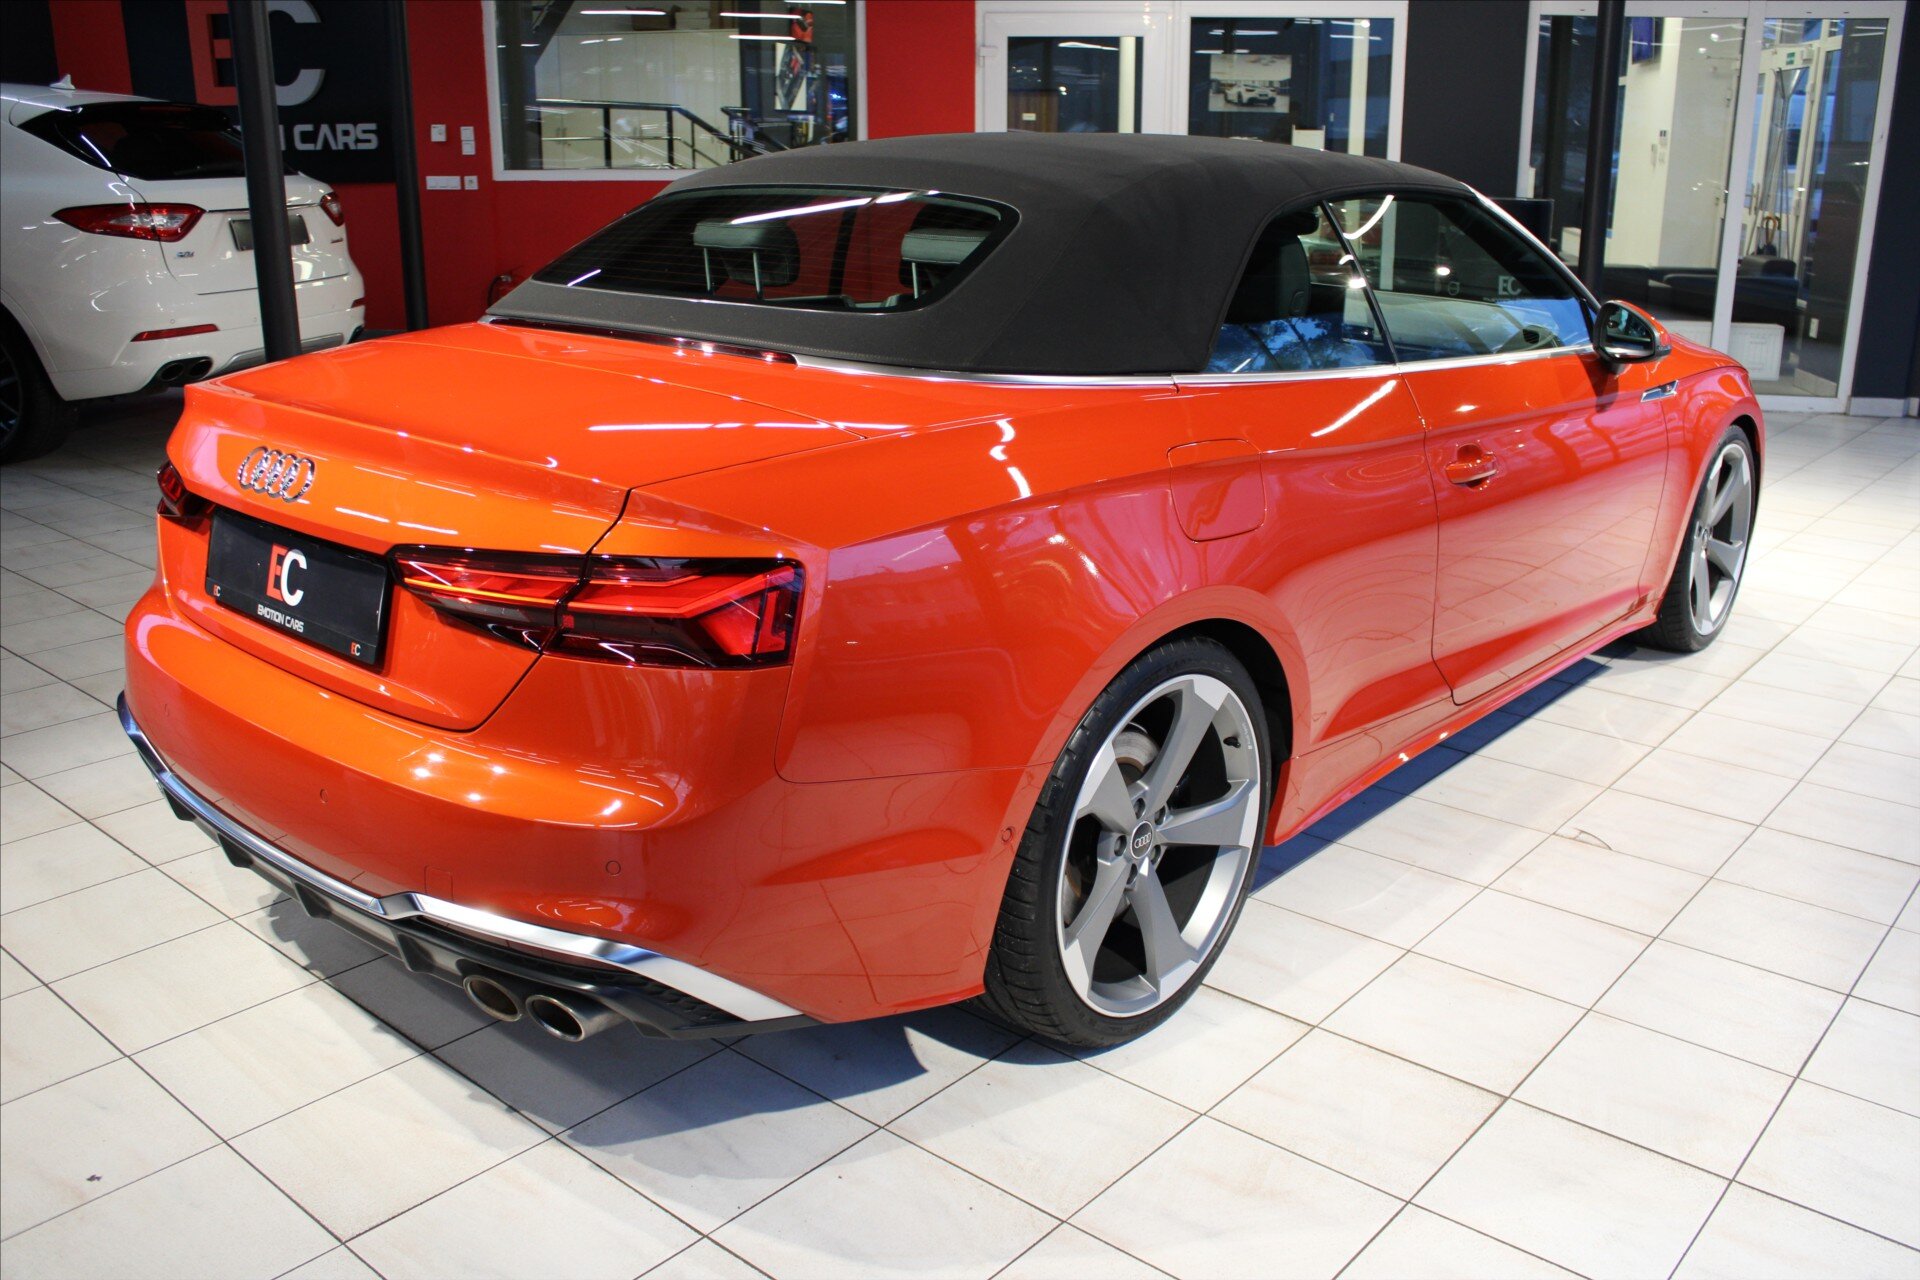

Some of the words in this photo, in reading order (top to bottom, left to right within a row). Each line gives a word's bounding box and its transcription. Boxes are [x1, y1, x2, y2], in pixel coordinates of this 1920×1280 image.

[293, 123, 379, 150] CARS
[1498, 275, 1522, 296] EC
[266, 544, 308, 607] EC
[257, 604, 285, 625] EMOTION
[284, 615, 305, 633] CARS
[350, 641, 361, 656] EC
